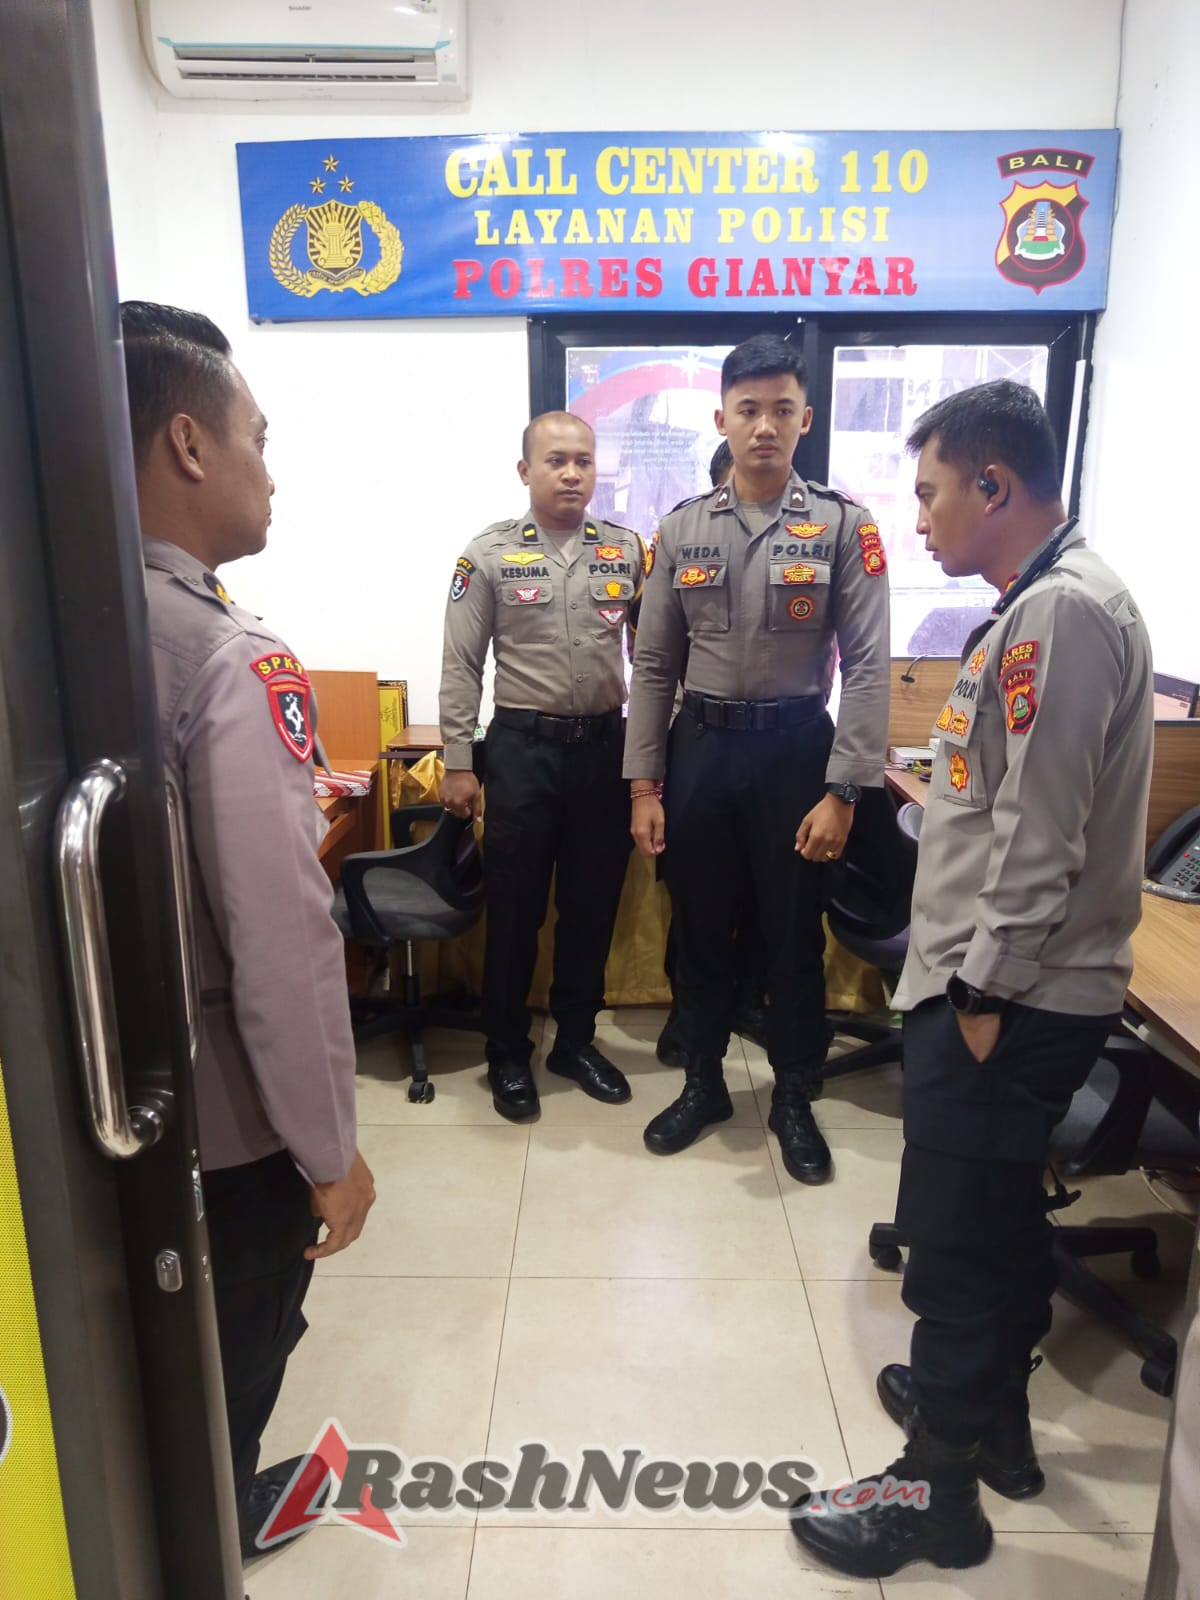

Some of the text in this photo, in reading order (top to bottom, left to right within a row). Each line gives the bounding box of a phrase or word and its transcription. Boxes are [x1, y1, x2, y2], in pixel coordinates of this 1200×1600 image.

[1008, 154, 1083, 171] BALI
[445, 146, 928, 198] CALL CENTER 110
[474, 206, 890, 245] LAYANAN POLISI
[452, 256, 918, 299] POLRES GIANYAR
[682, 546, 721, 559] WEDA
[773, 543, 831, 557] POLRI
[501, 566, 549, 578] KESUMA
[589, 563, 631, 575] POLRI
[258, 656, 303, 675] SPKT
[1007, 671, 1028, 687] BALI
[954, 679, 977, 701] POLRI
